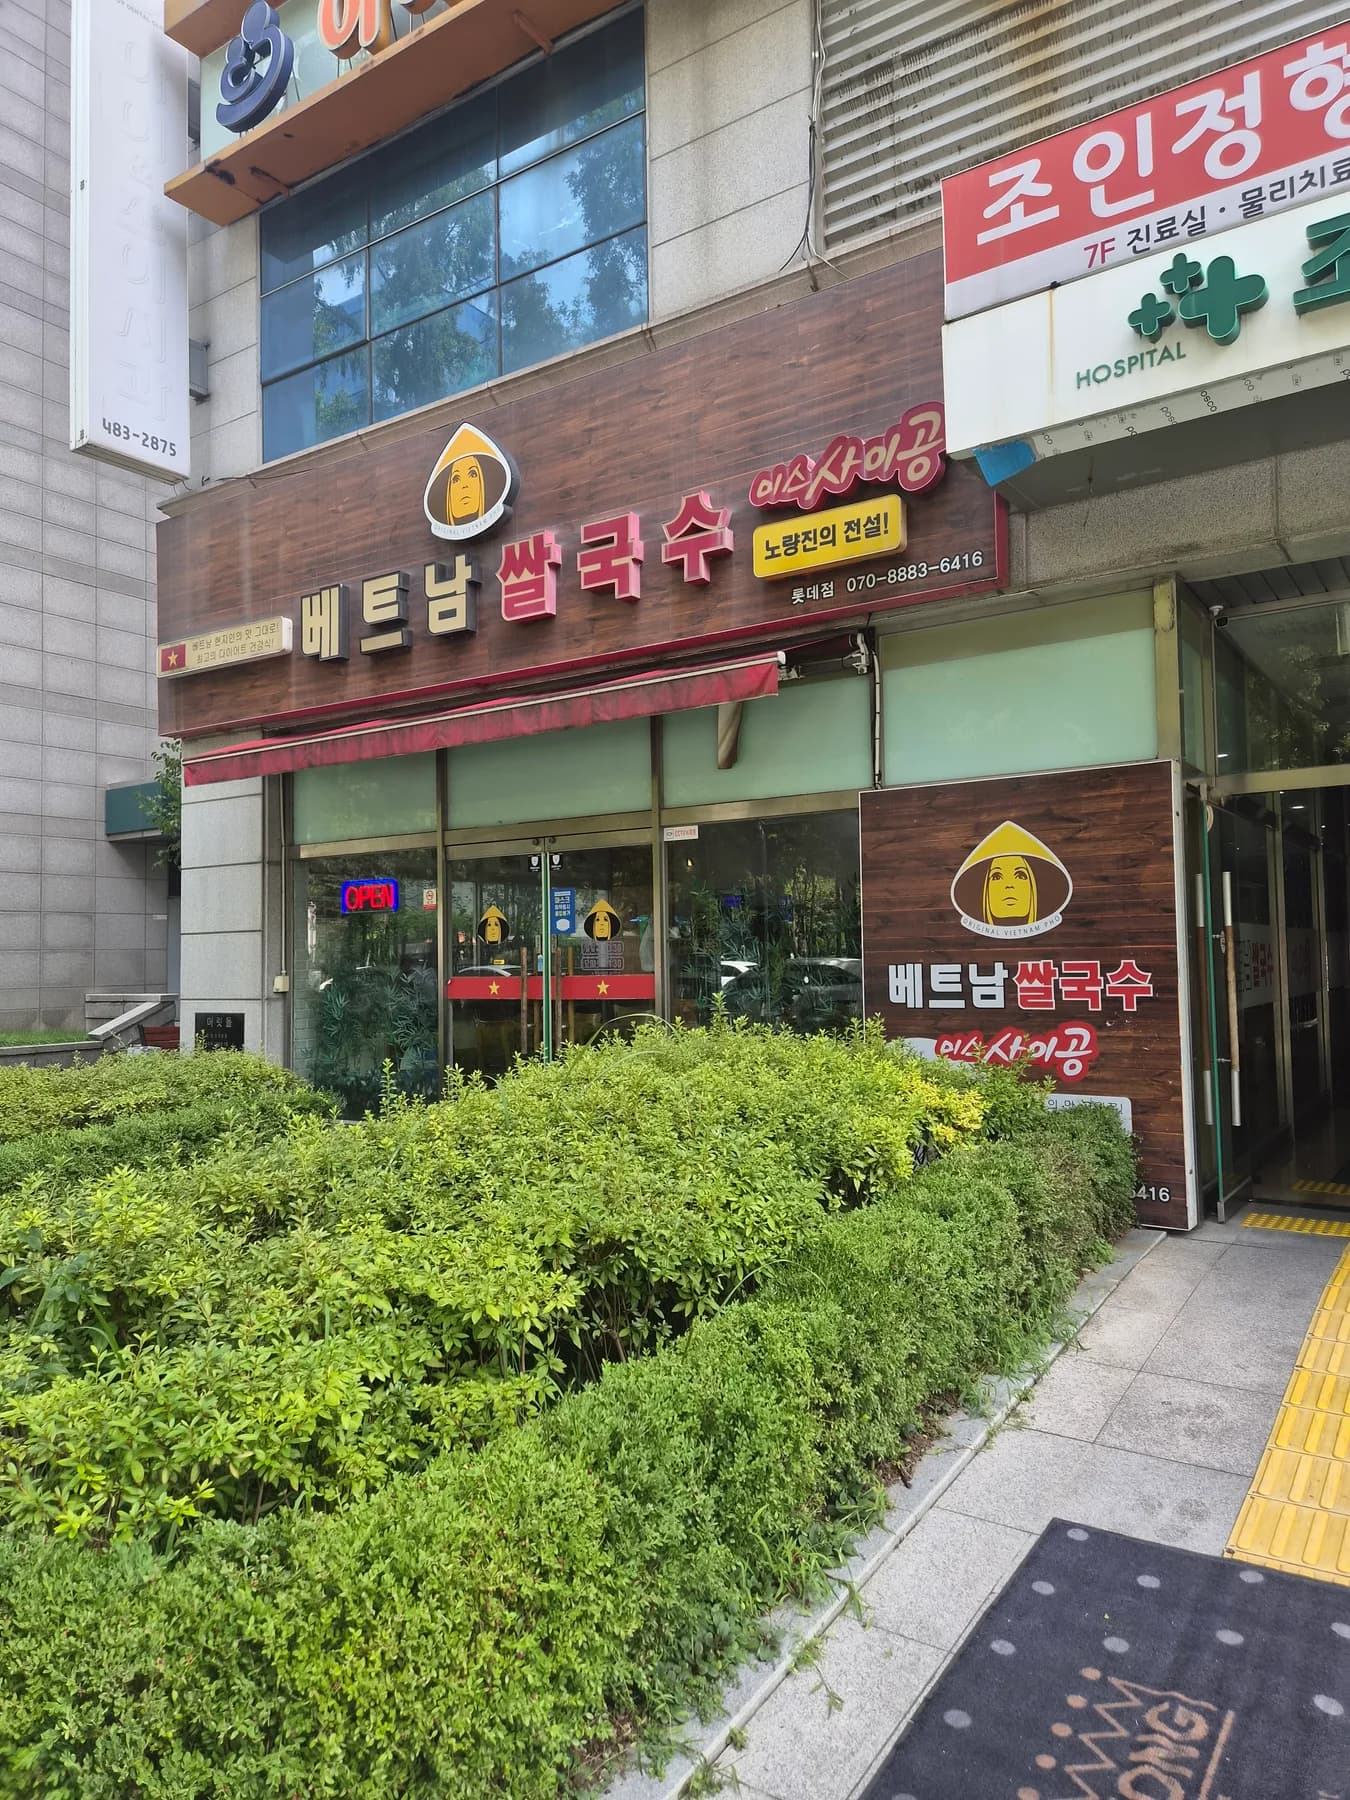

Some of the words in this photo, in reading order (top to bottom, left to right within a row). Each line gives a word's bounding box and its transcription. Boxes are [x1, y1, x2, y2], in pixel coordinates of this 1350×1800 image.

[1083, 238, 1115, 268] 7F
[1127, 206, 1206, 254] 진료실
[1076, 342, 1186, 389] HOSPITAL
[103, 417, 176, 457] 483-2875
[756, 411, 944, 500] 미스사이공
[764, 523, 837, 560] 노량진의
[844, 512, 889, 543] 전설!
[301, 552, 477, 661] 베트남
[496, 490, 734, 623] 쌀국수
[791, 581, 835, 605] 롯데점
[847, 550, 983, 593] 070-8883-6416
[345, 883, 394, 910] OPEN
[963, 918, 1000, 936] ORIGINAL
[1004, 924, 1040, 936] VIETNAM
[1044, 915, 1060, 927] PHO
[888, 961, 1009, 1010] 베트남
[1012, 959, 1153, 1011] 쌀국수
